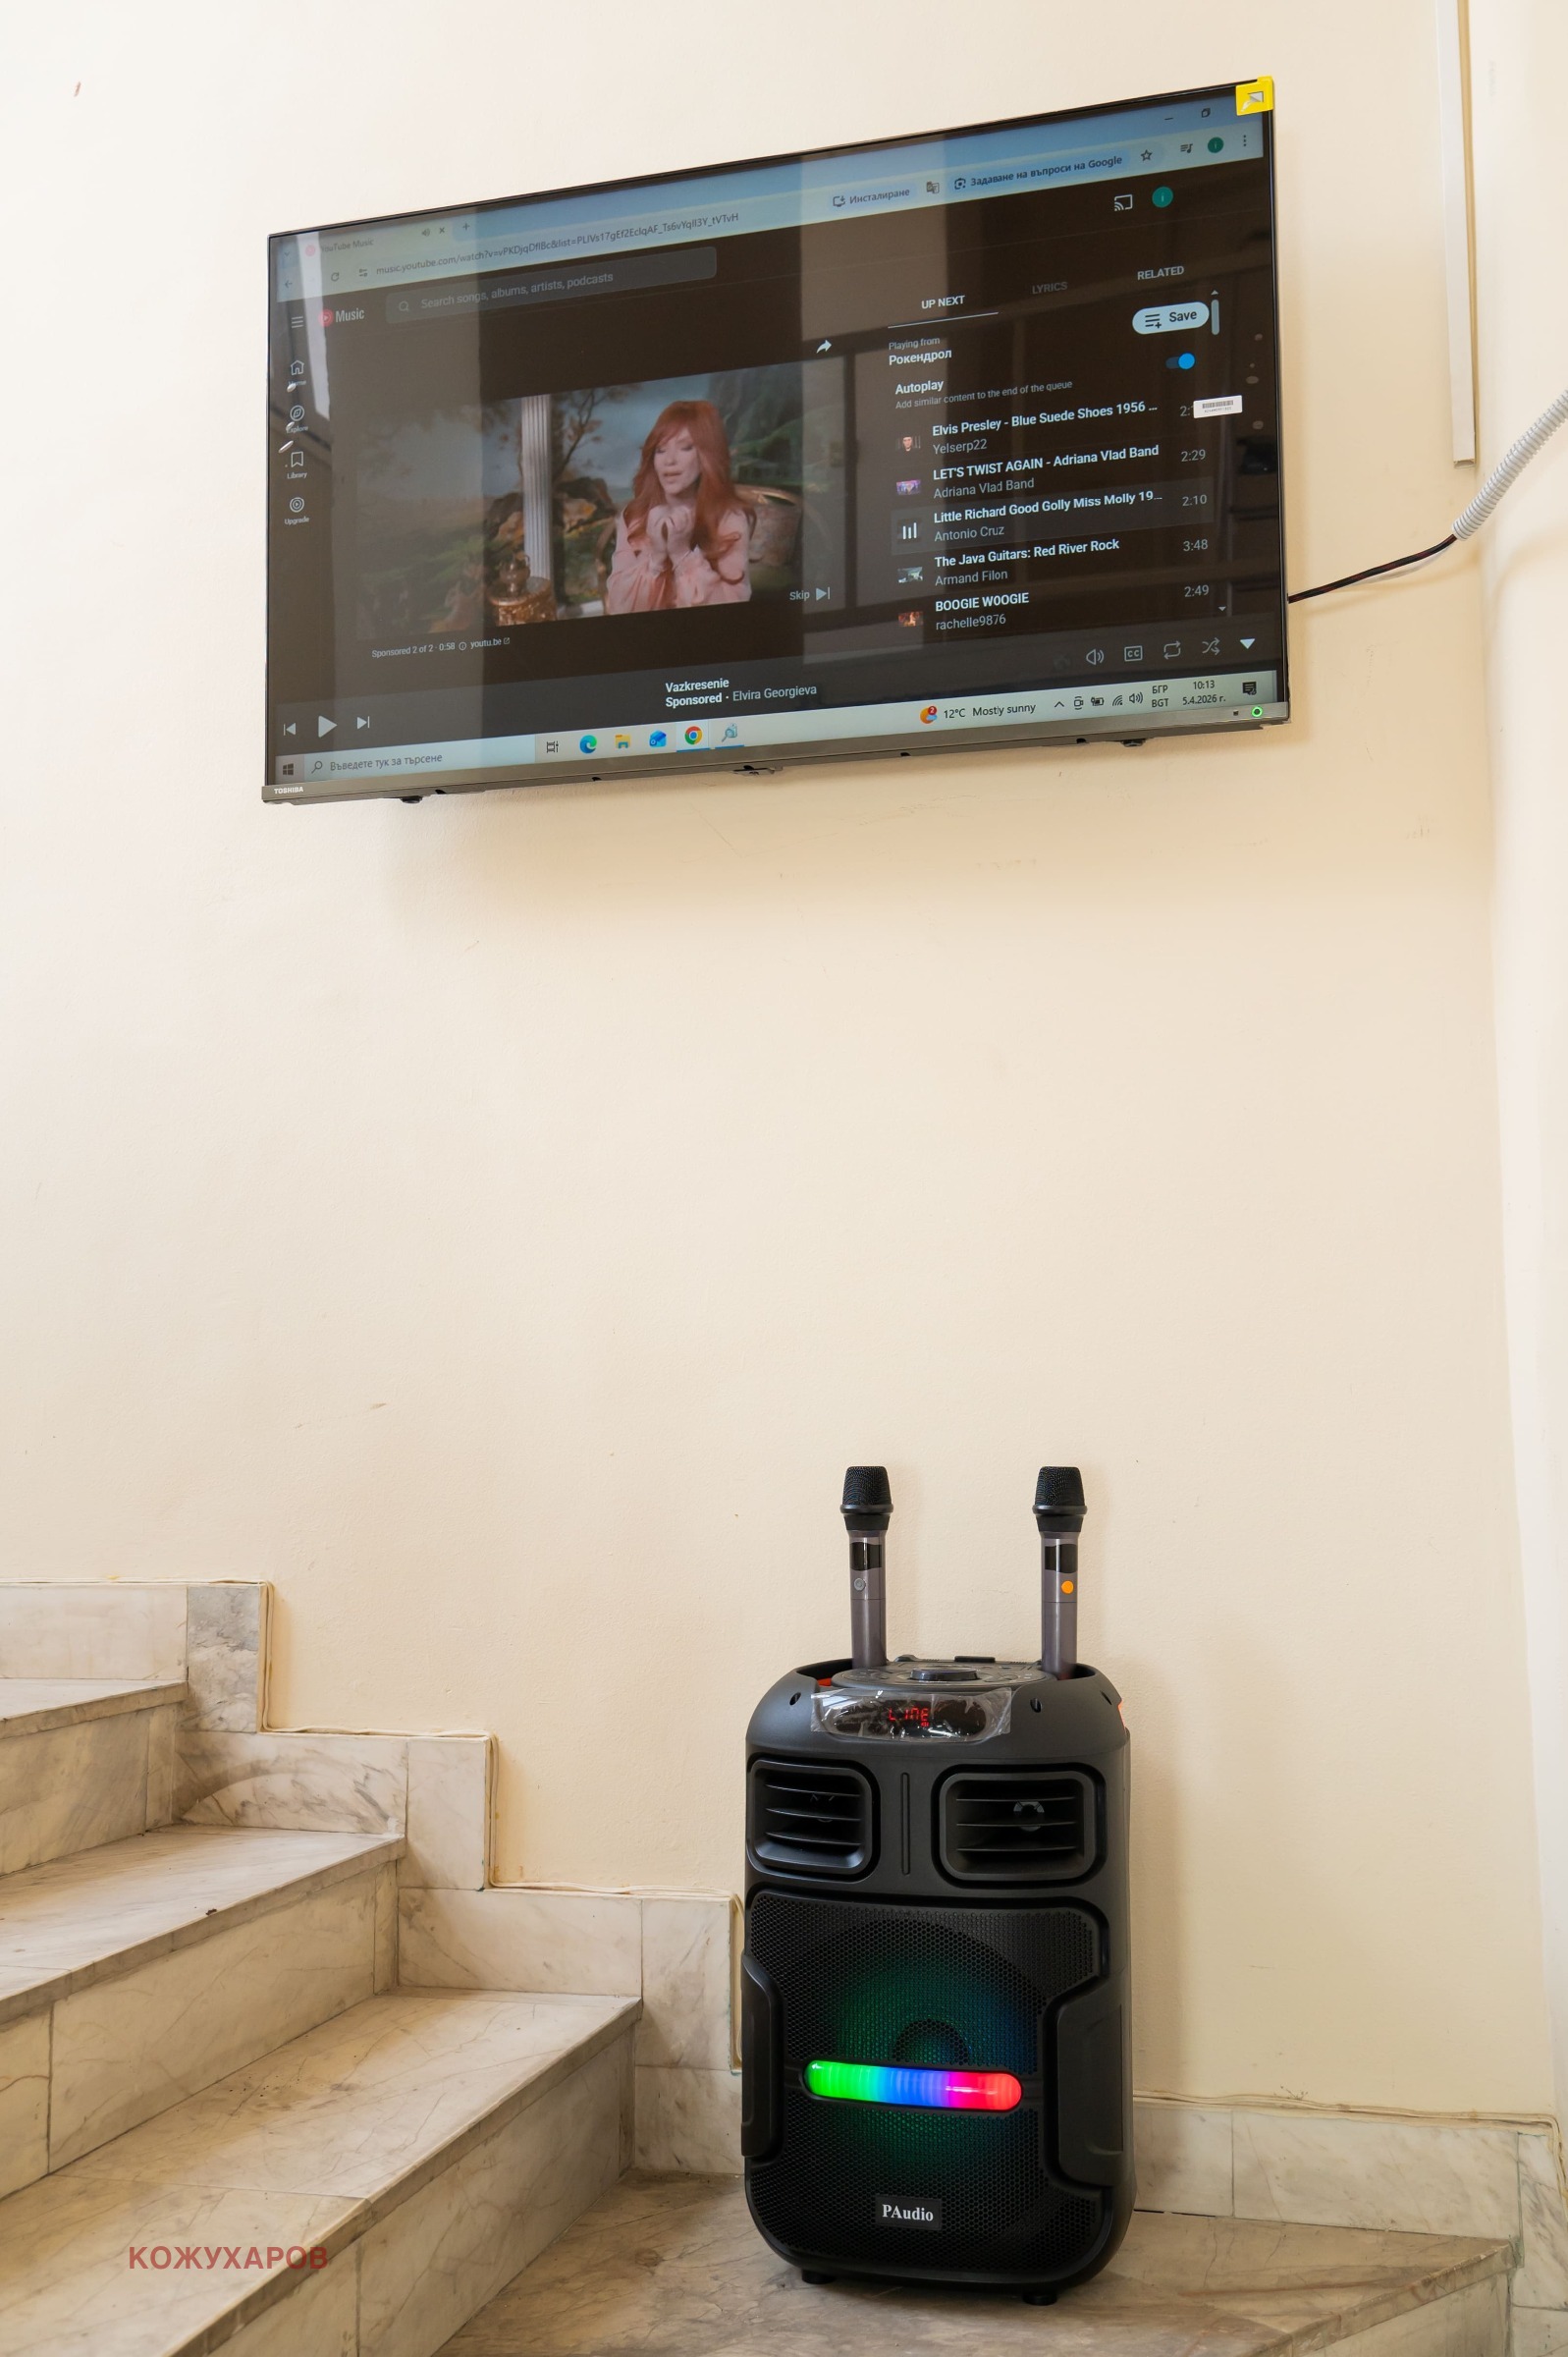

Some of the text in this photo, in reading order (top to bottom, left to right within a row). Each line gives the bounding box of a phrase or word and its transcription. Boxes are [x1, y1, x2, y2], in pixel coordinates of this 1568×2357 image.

[970, 173, 1014, 187] Задаване
[1030, 164, 1072, 178] въпроси
[1074, 161, 1086, 171] на
[1088, 156, 1123, 170] Google
[849, 189, 910, 204] Инсталиране
[353, 239, 374, 248] Music
[1137, 265, 1185, 281] RELATED
[420, 272, 614, 309] Search songs, albums, artists, podcasts
[1031, 282, 1068, 295] LYRICS
[921, 295, 965, 310] UP NEXT
[335, 307, 365, 323] Music
[1168, 308, 1198, 323] Save
[889, 337, 941, 351] Playing from
[889, 350, 952, 366] Рокендрол
[895, 380, 944, 395] Autoplay
[895, 381, 1073, 410] Add similar content to the end of the queue
[933, 424, 958, 436] Elvis
[961, 419, 1001, 433] Presley
[1011, 414, 1037, 427] Blue
[1039, 410, 1075, 423] Suede
[1077, 406, 1113, 418] Shoes
[1116, 401, 1146, 414] 1956
[933, 438, 988, 455] Yelserp22
[933, 466, 964, 480] LET'S
[966, 462, 1003, 475] TWIST
[1005, 458, 1044, 472] AGAIN
[1053, 453, 1098, 467] Adriana
[1100, 449, 1127, 462] Vlad
[1129, 445, 1160, 459] Band
[1181, 449, 1207, 463] 2:29
[287, 470, 307, 480] Library
[933, 477, 1035, 499] Adriana Vlad Band
[934, 511, 962, 523] Little
[964, 506, 1006, 521] Richard
[1009, 502, 1039, 515] Good
[1042, 497, 1070, 513] Golly
[1073, 495, 1101, 509] Miss
[1104, 491, 1136, 507] Molly
[1181, 493, 1208, 507] 2:10
[284, 516, 310, 525] Upgrade
[934, 525, 1004, 542] Antonio Cruz
[1182, 538, 1209, 552] 3:48
[934, 538, 1119, 568] The Java Guitars: Red River Rock
[935, 569, 1008, 586] Armand Filon
[789, 589, 810, 602] Skip
[1184, 584, 1210, 598] 2:49
[935, 597, 980, 612] BOOGIE
[936, 614, 1006, 630] rachelle9876
[470, 637, 502, 649] youtu.be
[371, 646, 410, 659] Sponsored
[412, 645, 418, 654] 2
[419, 644, 427, 653] of
[666, 678, 730, 693] Vazkresenie
[1152, 685, 1168, 694] БГР
[1192, 680, 1216, 690] 10:13
[666, 692, 723, 709] Sponsored
[732, 690, 761, 702] Elvira
[764, 685, 818, 701] Georgieva
[1151, 698, 1169, 708] BGT
[1182, 693, 1218, 706] 5.4.2026
[944, 701, 1037, 719] 12°C Mostly sunny
[330, 753, 443, 772] Въведете тук за търсене
[274, 786, 303, 795] TOSHIBA
[882, 2204, 934, 2221] PAudio
